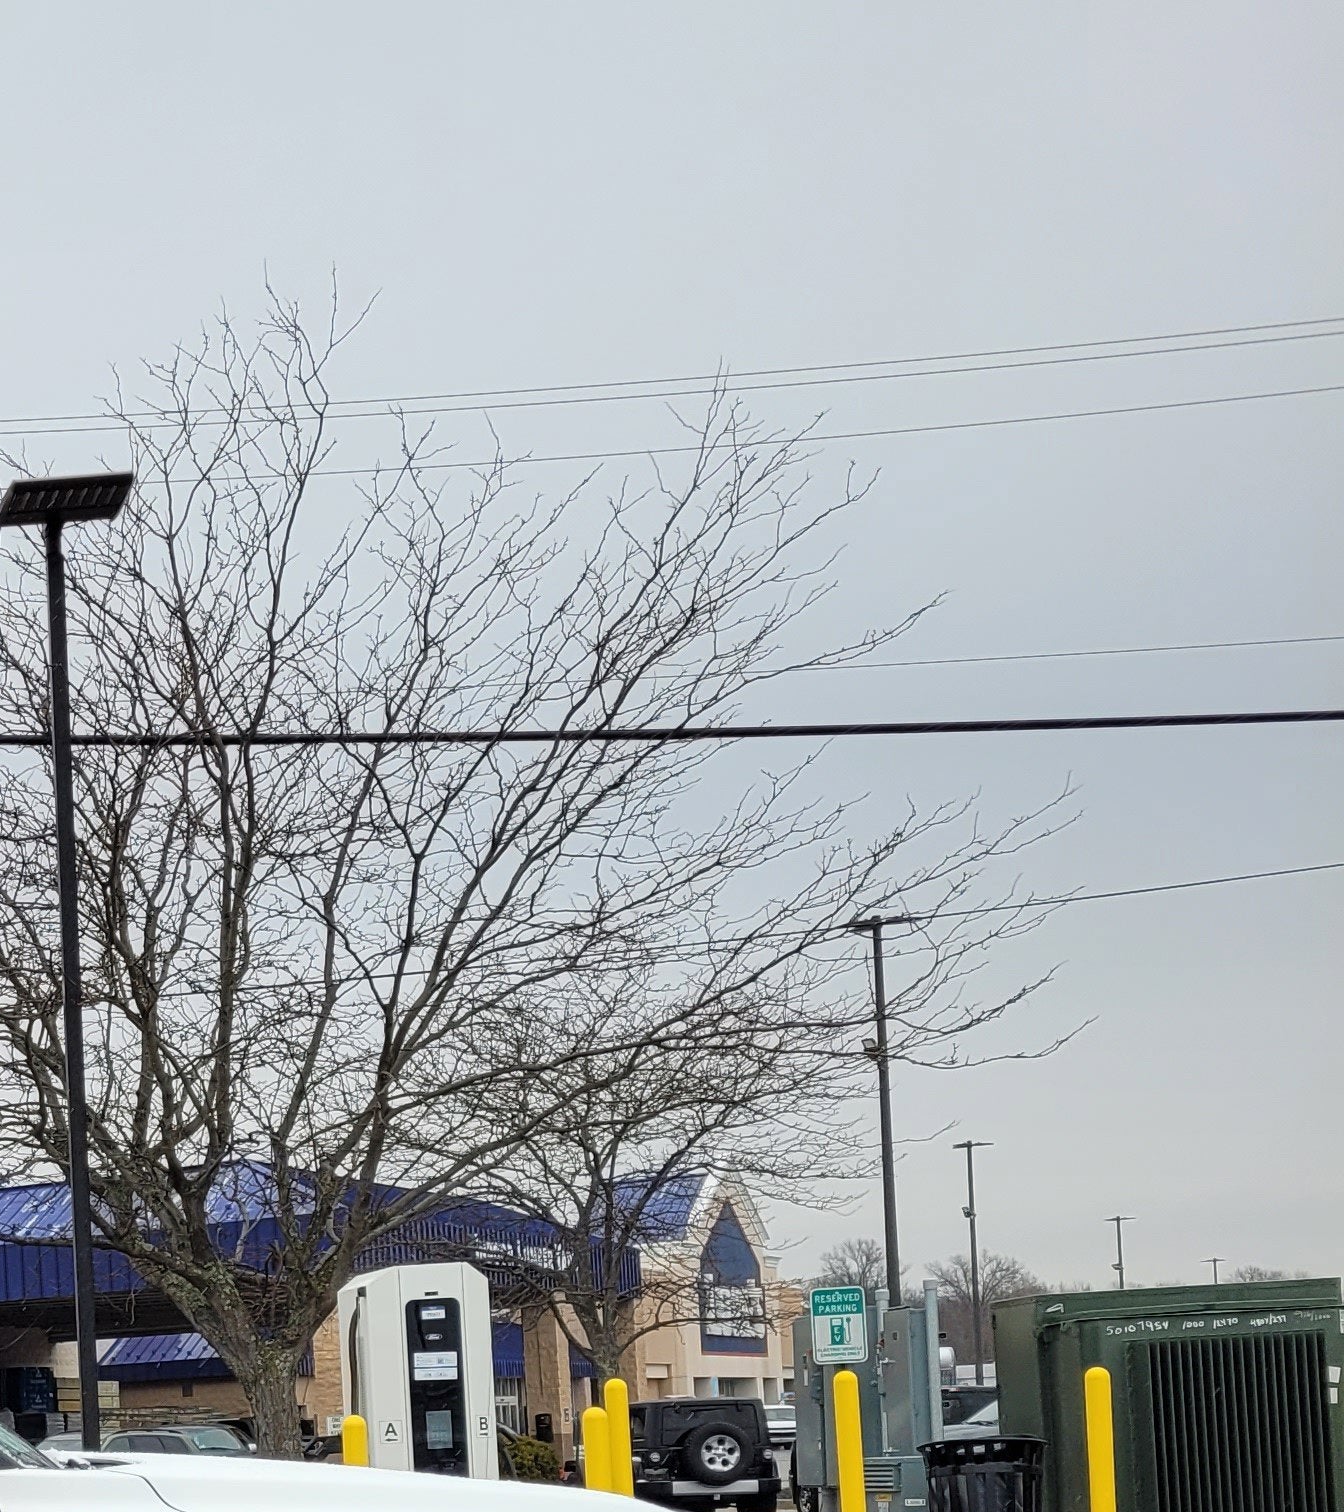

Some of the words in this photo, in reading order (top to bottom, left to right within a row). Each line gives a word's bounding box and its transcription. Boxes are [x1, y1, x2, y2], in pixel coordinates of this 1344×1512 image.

[814, 1293, 860, 1303] RESERVED
[818, 1304, 857, 1314] PARKING
[384, 1422, 398, 1437] A
[479, 1416, 489, 1431] B
